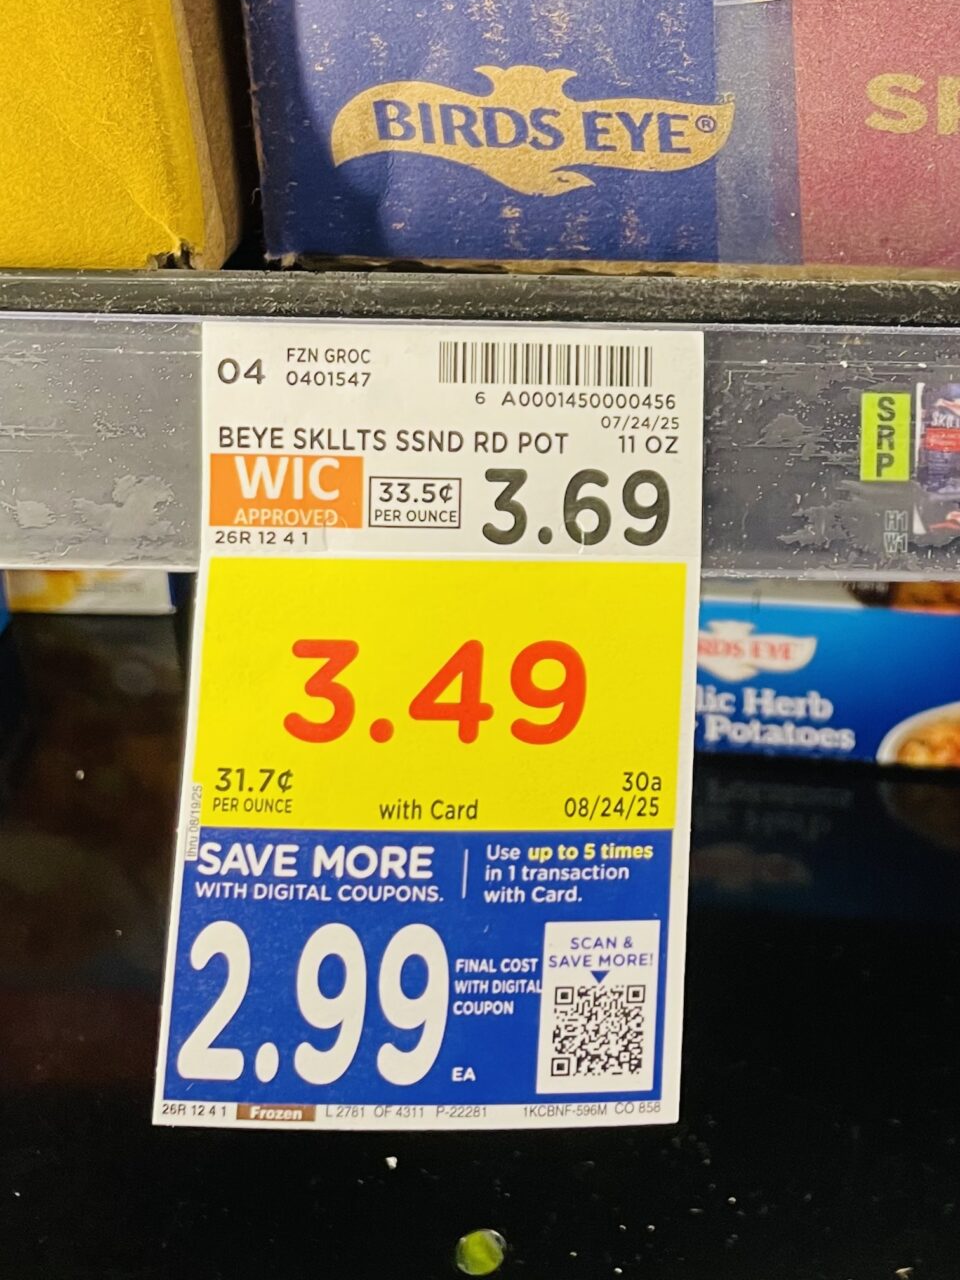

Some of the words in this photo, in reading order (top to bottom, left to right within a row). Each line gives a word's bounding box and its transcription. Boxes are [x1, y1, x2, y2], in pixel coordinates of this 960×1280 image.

[372, 98, 566, 152] BIRDS
[217, 358, 266, 385] 04
[286, 347, 319, 364] FZN
[324, 348, 372, 365] GROC
[286, 370, 372, 388] 0401547
[475, 391, 487, 406] 6
[501, 391, 677, 410] A0001450000456
[601, 415, 680, 431] 07/24/25
[218, 426, 285, 450] BEYE
[293, 428, 388, 452] SKLLTS
[396, 430, 465, 453] SSND
[474, 431, 509, 453] RD
[518, 432, 570, 455] POT
[618, 435, 636, 454] 11
[645, 435, 680, 455] OZ
[233, 456, 341, 501] WIC
[233, 508, 339, 527] APPROVED
[374, 508, 402, 523] PER
[406, 509, 458, 524] OUNCE
[378, 482, 454, 505] 33.5¢
[482, 468, 672, 548] 3.69
[215, 531, 252, 546] 26R
[259, 531, 277, 546] 12
[283, 531, 295, 546] 4
[302, 531, 310, 546] 1
[283, 639, 588, 746] 3.49
[742, 686, 835, 720] Herb
[704, 714, 857, 752] Potatoes
[214, 767, 295, 794] 31.7¢
[622, 772, 663, 793] 30a
[212, 796, 240, 813] PER
[243, 797, 293, 814] OUNCE
[378, 799, 426, 821] with
[430, 799, 479, 822] Card
[564, 797, 660, 819] 08/24/25
[197, 842, 300, 878] SAVE
[312, 844, 436, 881] MORE
[486, 844, 522, 862] Use
[527, 846, 554, 864] up
[558, 844, 579, 860] to
[583, 843, 597, 860] 5
[601, 843, 655, 860] times
[485, 866, 503, 882] in
[507, 866, 517, 882] 1
[521, 864, 630, 882] transaction
[195, 881, 249, 900] WITH
[253, 883, 333, 902] DIGITAL
[338, 884, 445, 903] COUPONS.
[484, 887, 526, 904] with
[531, 886, 584, 904] Card.
[570, 936, 618, 951] SCAN
[623, 936, 634, 950] &
[455, 957, 498, 974] FINAL
[500, 957, 540, 974] COST
[548, 954, 593, 969] SAVE
[598, 953, 655, 968] MORE!
[454, 979, 491, 995] WITH
[491, 978, 543, 995] DIGITAL
[177, 920, 450, 1088] 2.99
[453, 1000, 515, 1017] COUPON
[451, 1066, 477, 1083] EA
[191, 1104, 207, 1117] 12
[209, 1104, 218, 1117] 4
[249, 1104, 304, 1121] Frozen
